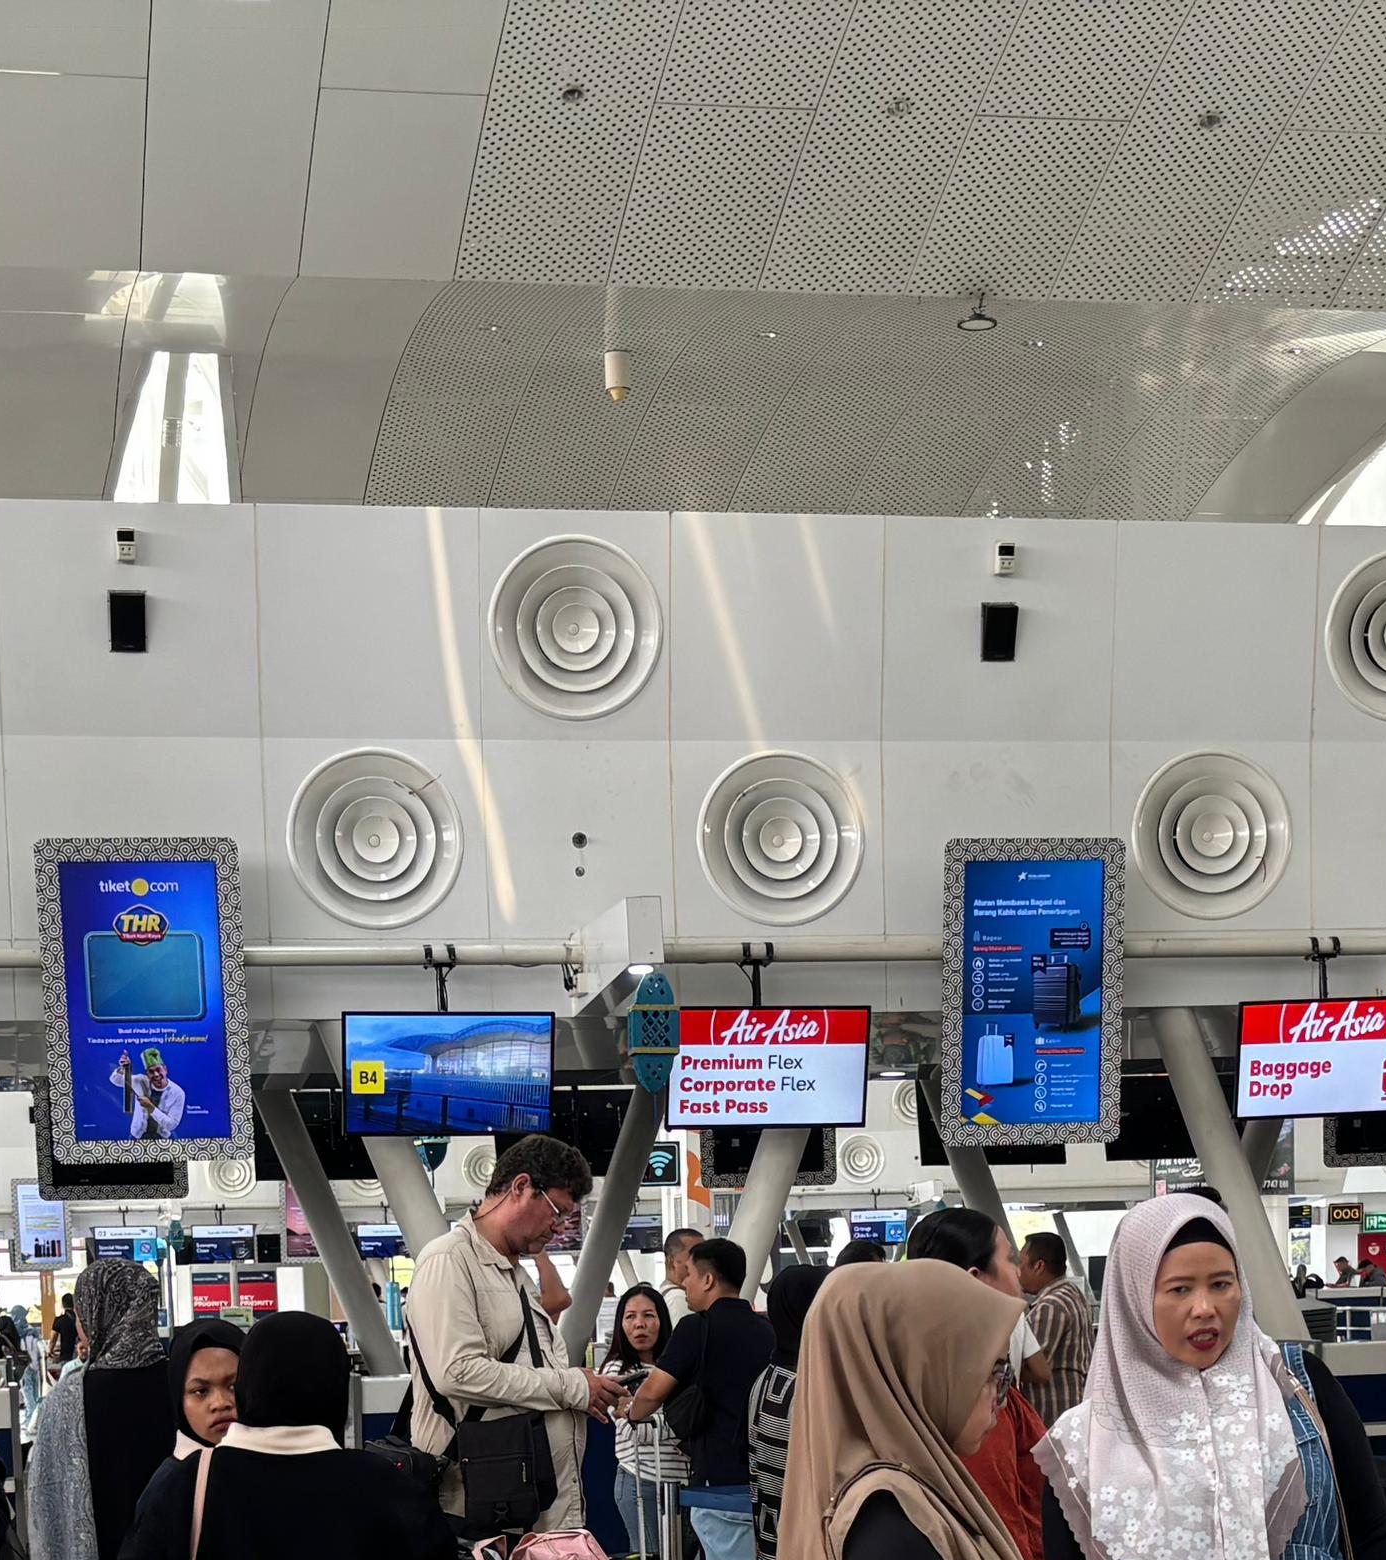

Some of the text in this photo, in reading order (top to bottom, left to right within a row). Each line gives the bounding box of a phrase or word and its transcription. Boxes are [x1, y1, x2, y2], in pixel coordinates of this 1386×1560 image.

[973, 908, 997, 918] Barang
[120, 914, 161, 933] THR
[680, 1055, 803, 1071] Premium Flex
[1250, 1059, 1332, 1080] Baggage
[358, 1070, 377, 1085] B4
[680, 1076, 816, 1095] Corporate Flex
[1248, 1080, 1293, 1100] Drop
[679, 1098, 768, 1114] Fast Pass
